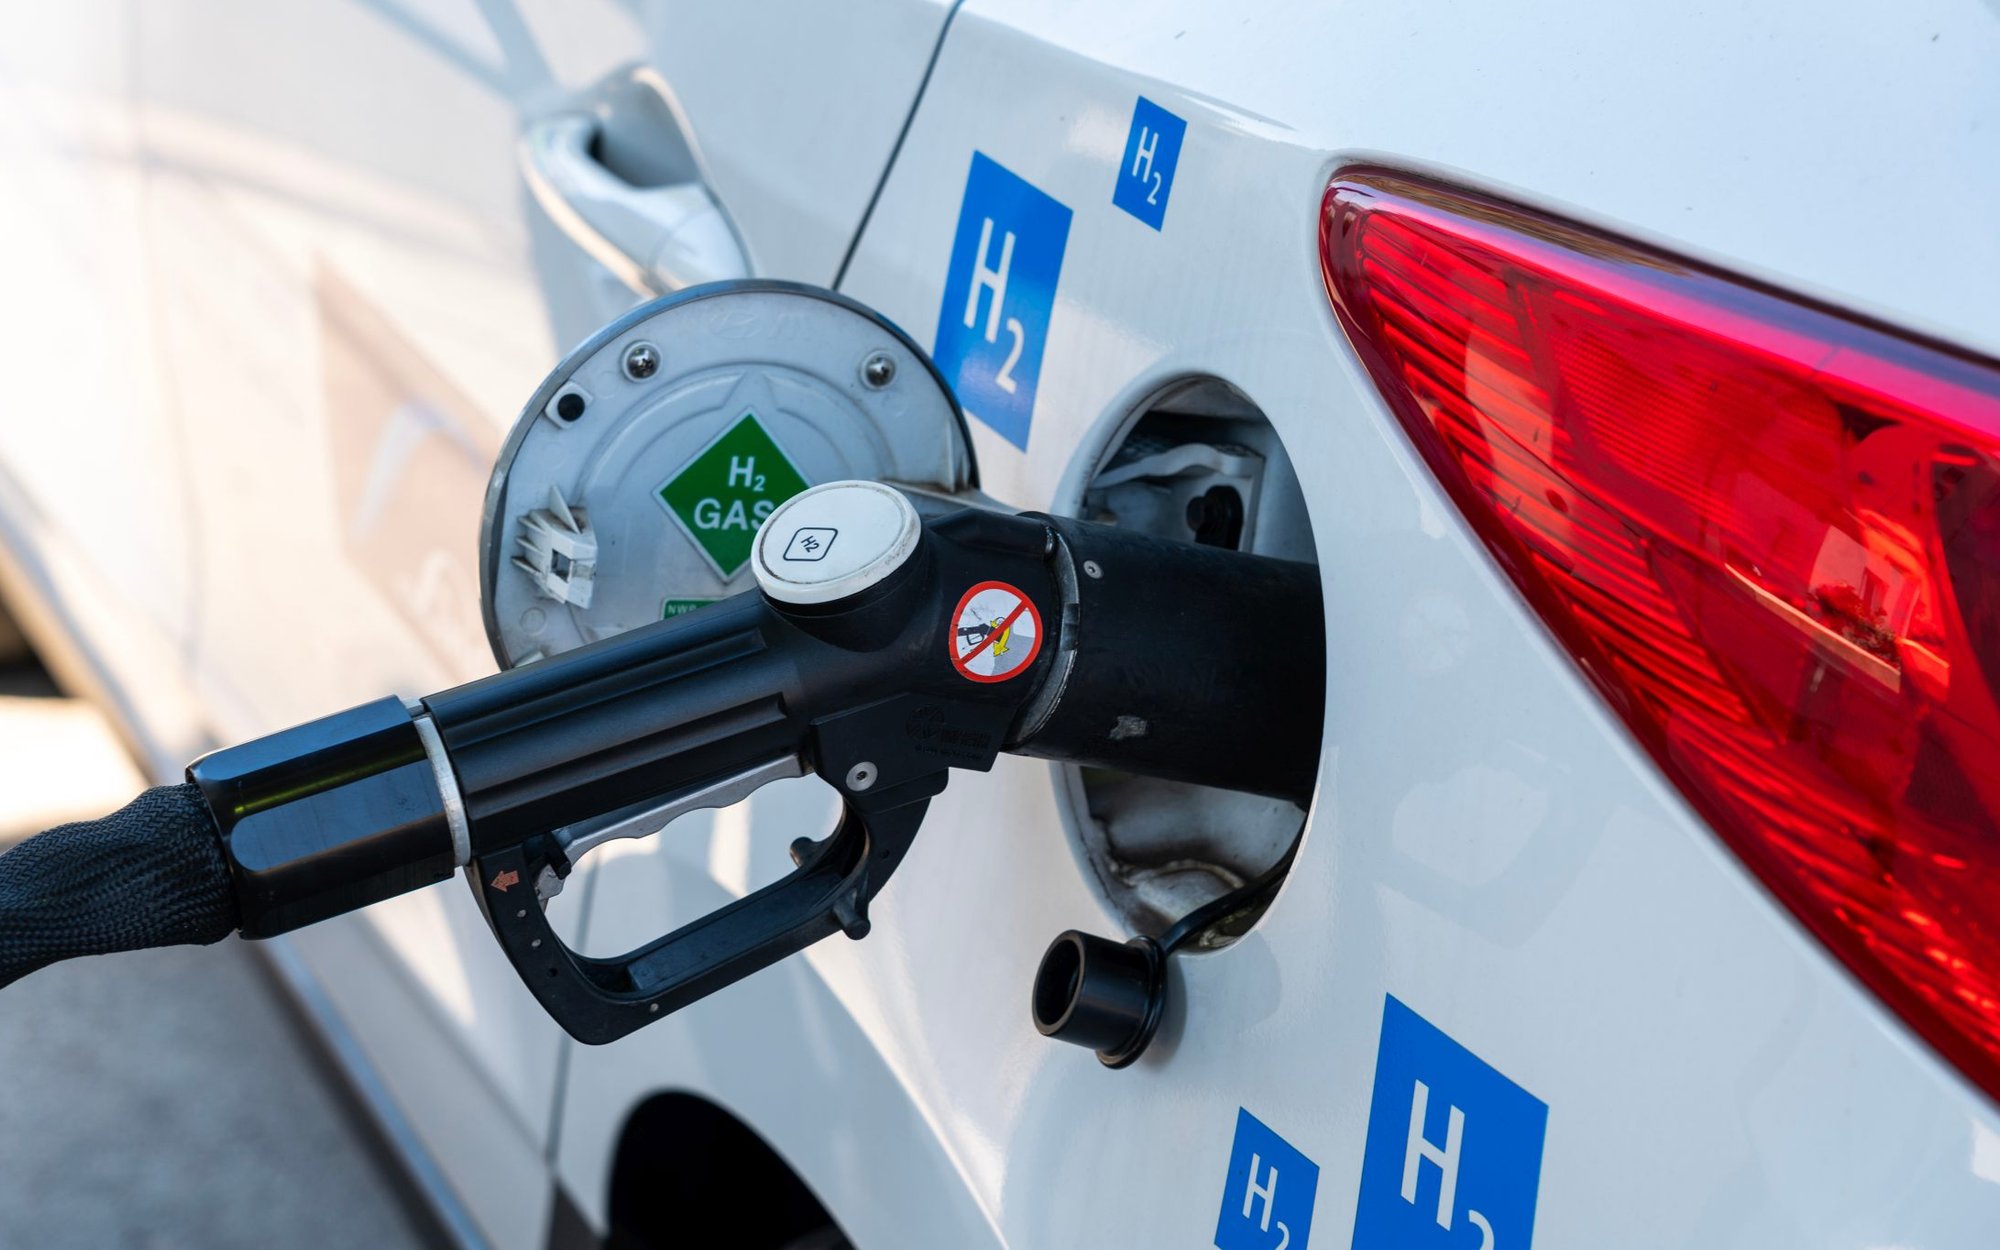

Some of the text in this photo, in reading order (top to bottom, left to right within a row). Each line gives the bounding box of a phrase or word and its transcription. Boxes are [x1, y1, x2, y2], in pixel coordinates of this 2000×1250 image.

[1132, 126, 1162, 205] H2
[963, 217, 1025, 395] H2
[728, 455, 766, 492] H2
[694, 498, 775, 531] GAS
[800, 535, 820, 553] H2
